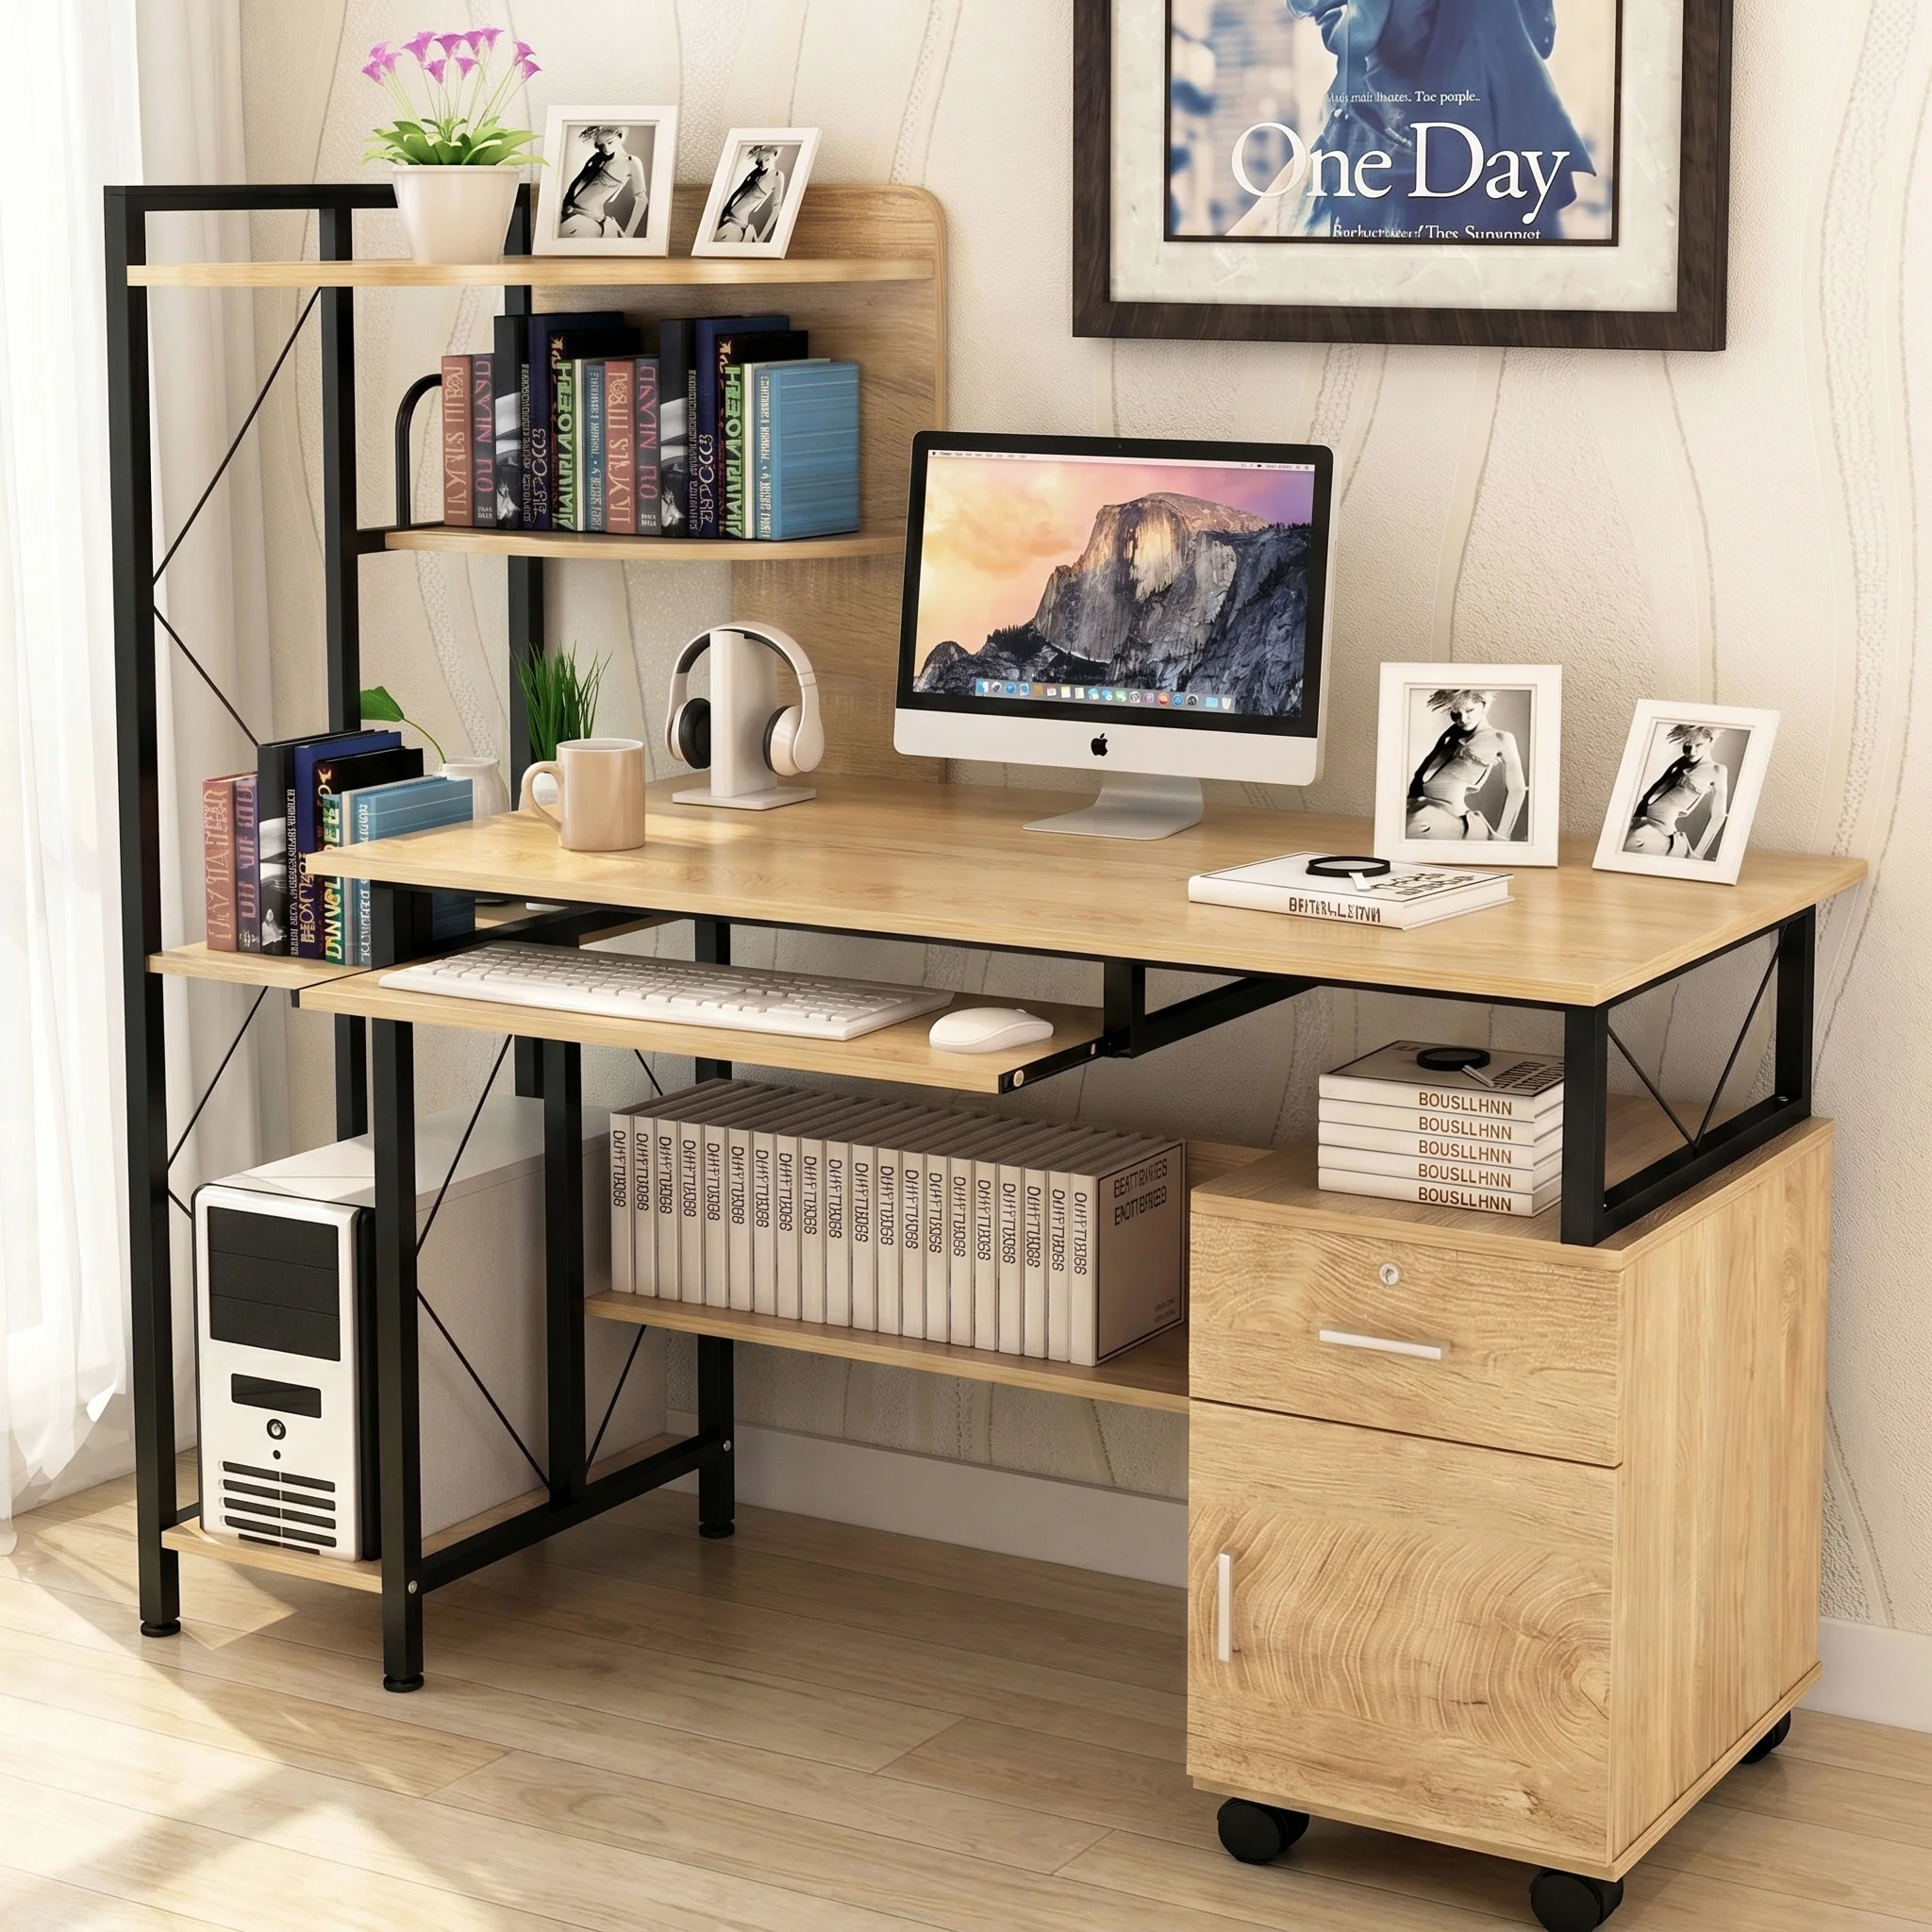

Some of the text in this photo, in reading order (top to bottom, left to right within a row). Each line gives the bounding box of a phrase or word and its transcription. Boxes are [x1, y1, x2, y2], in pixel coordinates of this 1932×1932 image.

[1230, 121, 1571, 225] One Day
[1418, 1091, 1512, 1116] BOUSLLHNN
[1418, 1116, 1512, 1141] BOUSLLHNN
[1418, 1140, 1512, 1164] BOUSLLHNN
[1418, 1163, 1511, 1189] BOUSLLHNN
[1418, 1187, 1511, 1212] BOUSLLHNN
